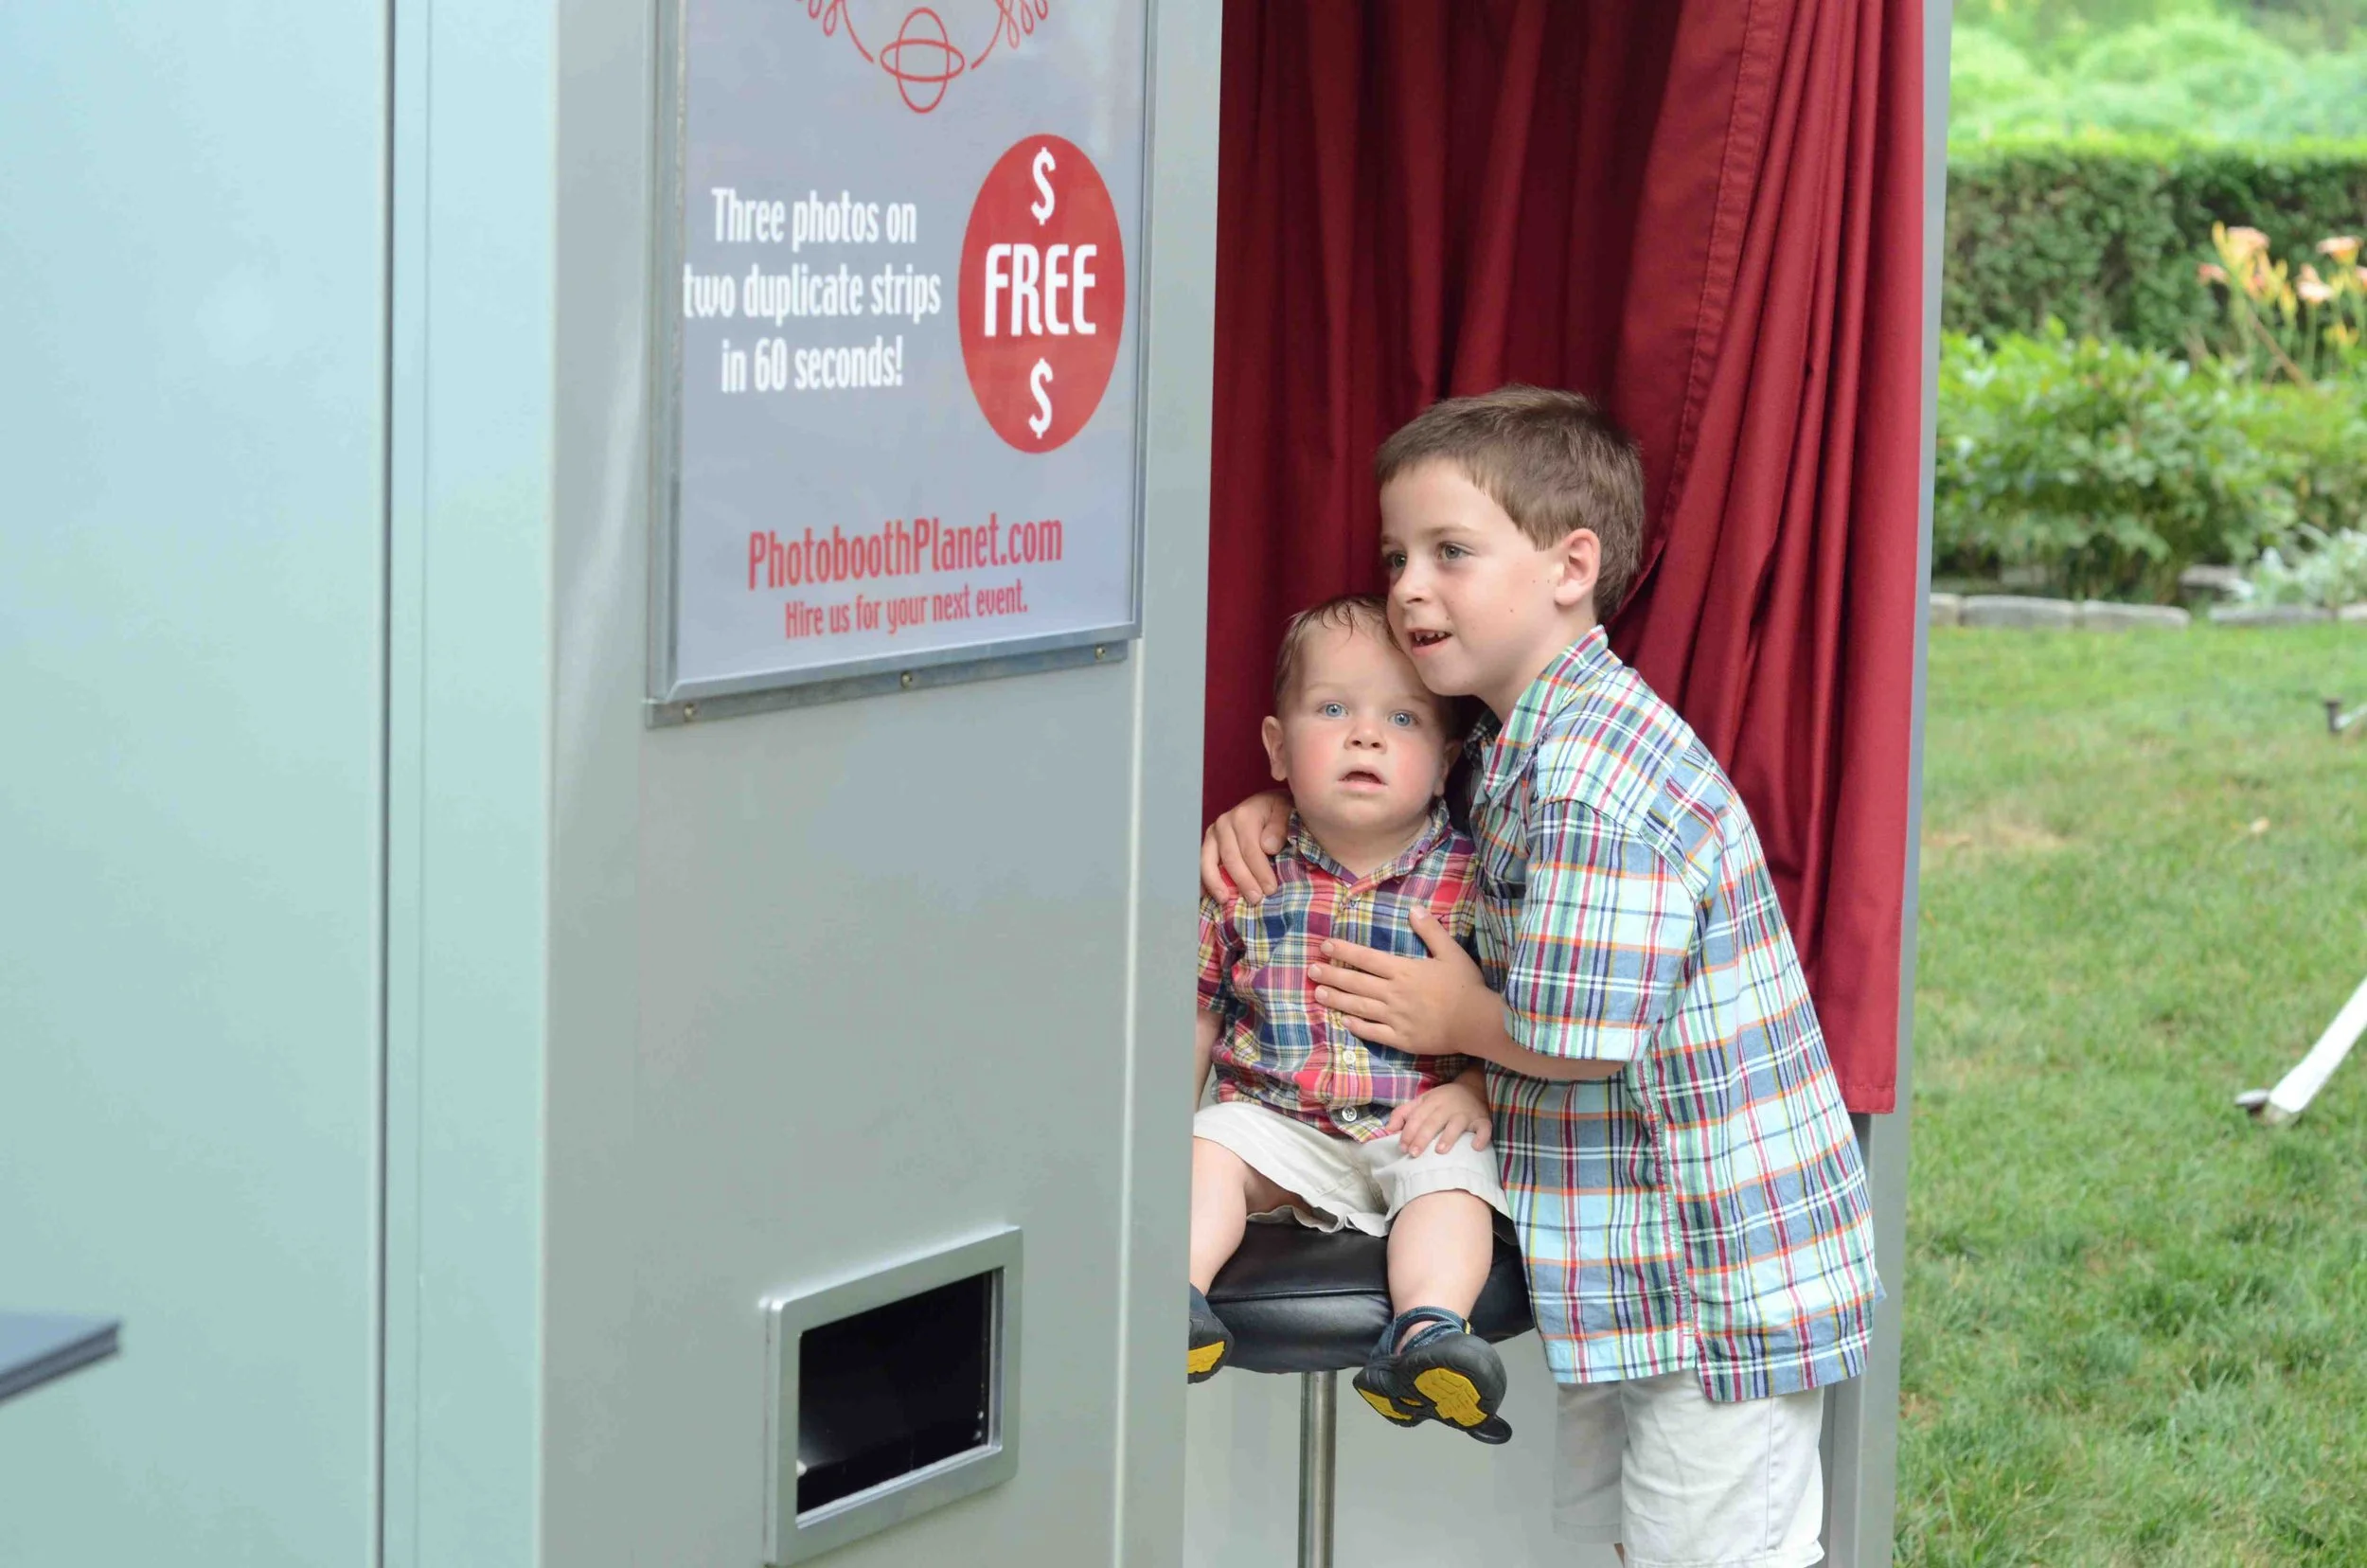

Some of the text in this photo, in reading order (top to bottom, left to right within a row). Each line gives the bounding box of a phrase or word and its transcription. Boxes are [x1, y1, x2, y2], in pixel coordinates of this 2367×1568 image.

[711, 187, 917, 254] Three photos on
[1030, 146, 1057, 225] $
[682, 261, 942, 328] two duplicate strips
[984, 242, 1097, 337] FREE
[721, 334, 904, 394] in 60 seconds!
[1027, 356, 1054, 439] $
[747, 511, 1063, 592] PhotoboothPlanet.com
[784, 577, 1028, 639] Hire us for your next event.
